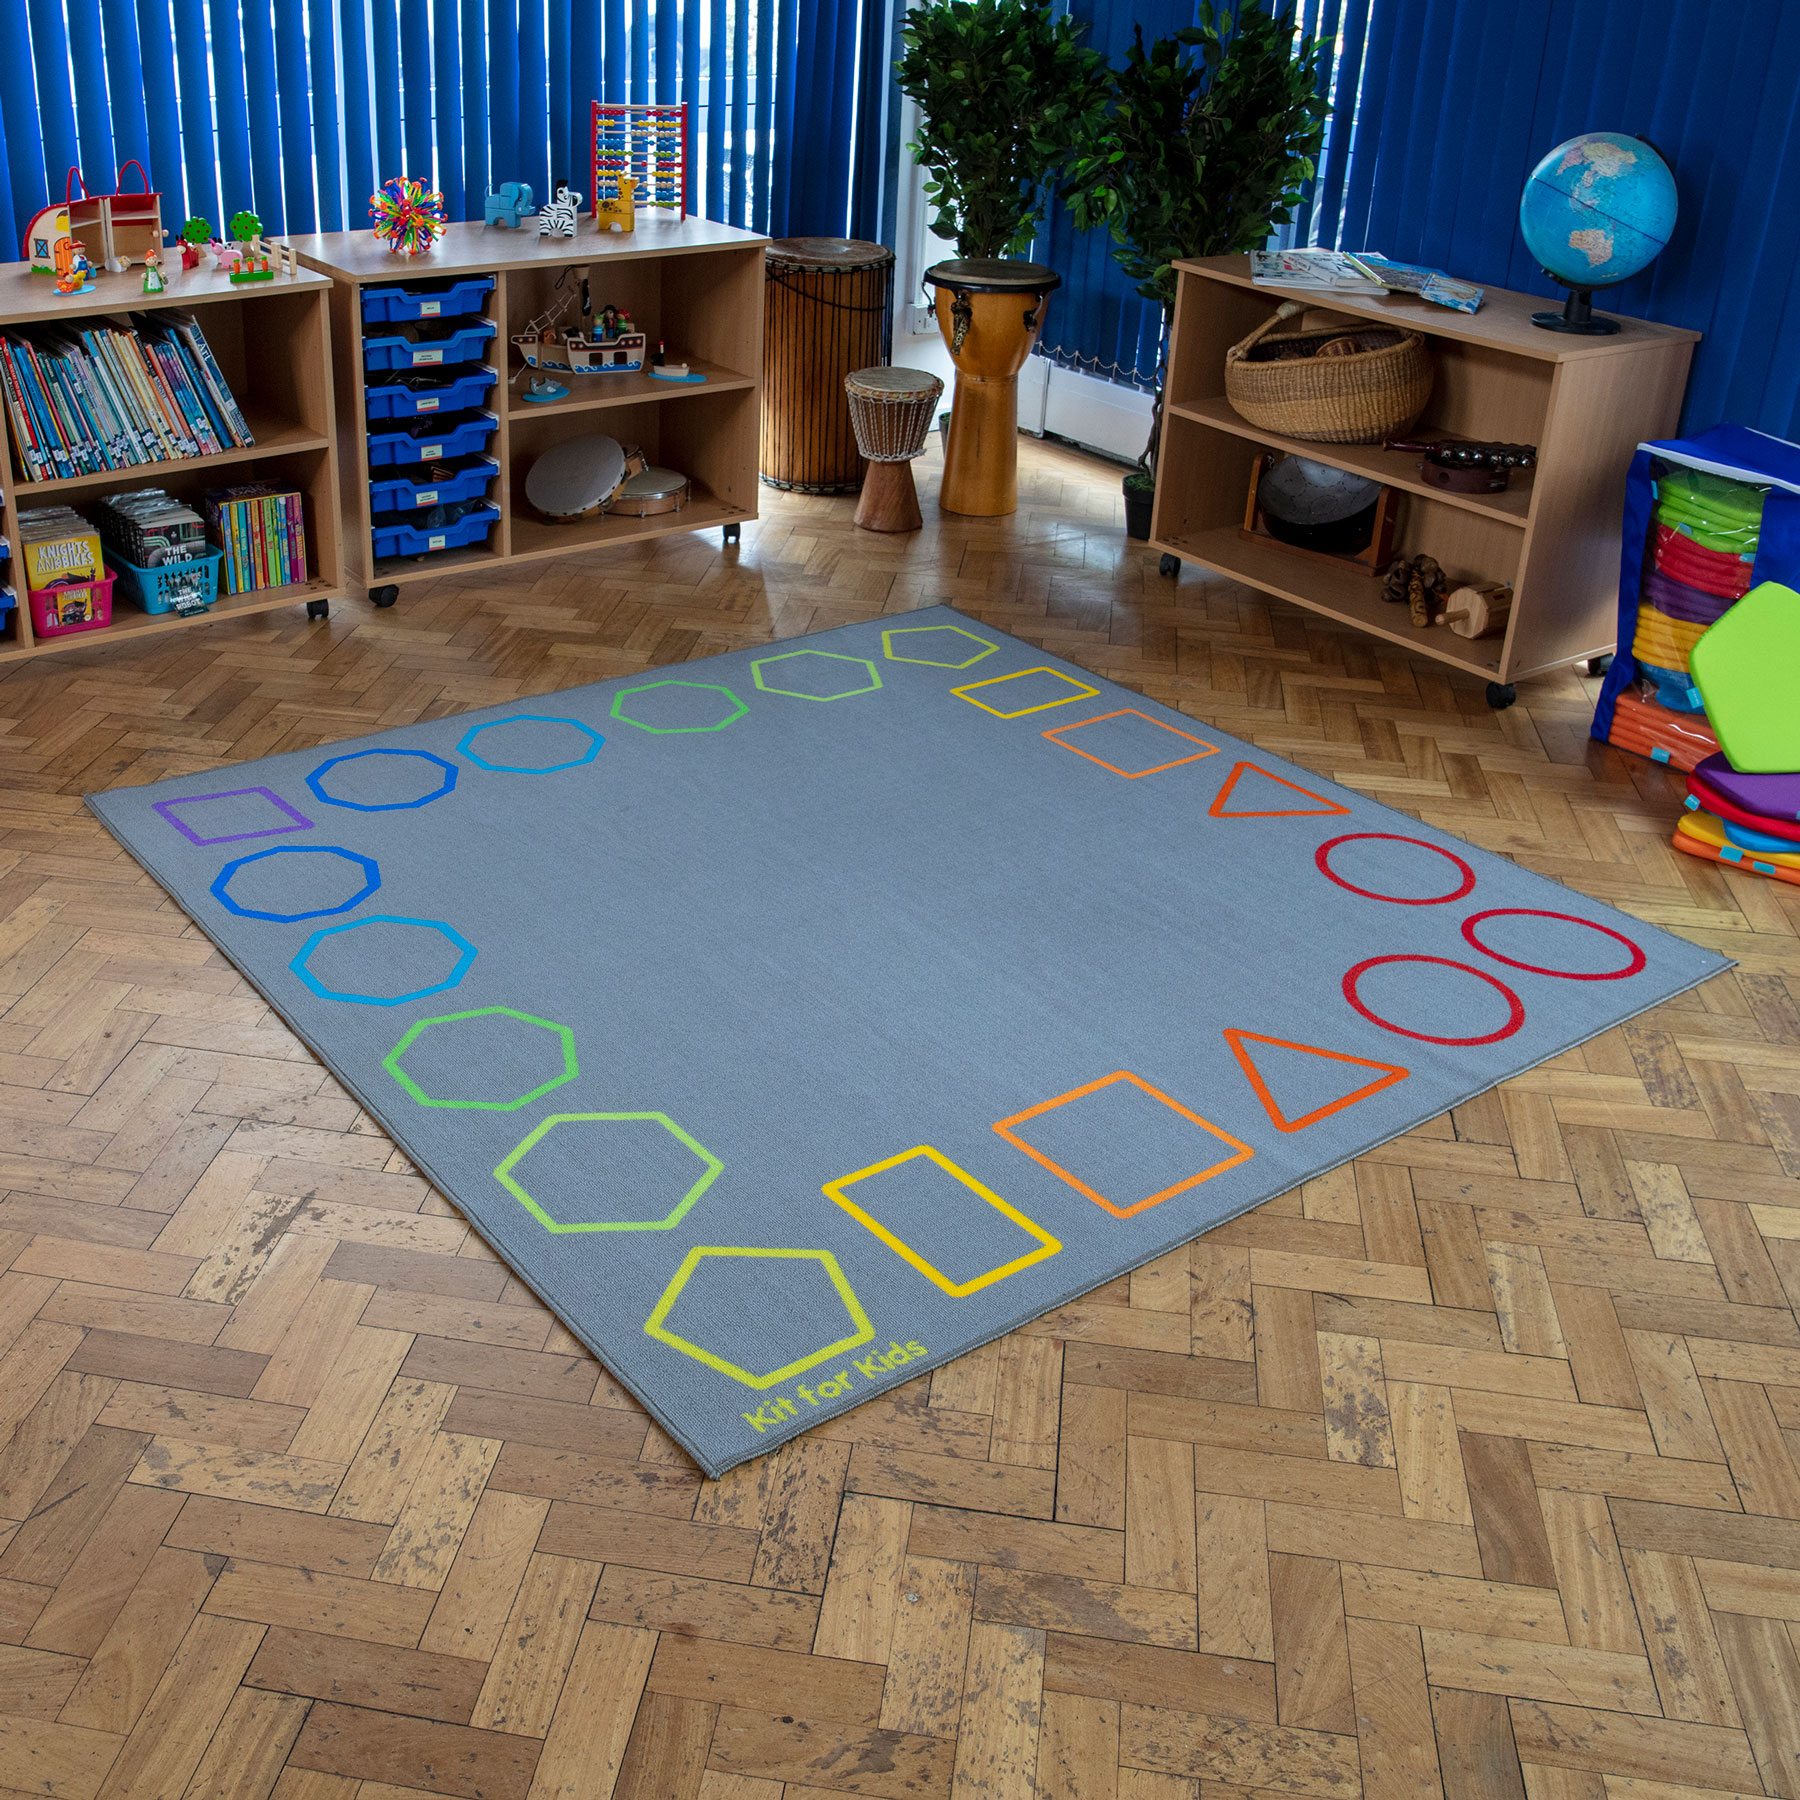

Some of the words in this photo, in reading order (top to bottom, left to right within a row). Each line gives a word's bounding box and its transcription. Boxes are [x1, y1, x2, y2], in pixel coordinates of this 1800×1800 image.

[198, 343, 211, 360] Art
[155, 376, 167, 399] MONET
[38, 540, 90, 559] KNIGHTS
[165, 545, 187, 556] THE
[37, 557, 62, 572] AND
[61, 552, 95, 569] BIKES
[162, 553, 193, 566] WILD
[178, 587, 192, 596] THE
[176, 598, 201, 610] ROBOT
[741, 1397, 798, 1433] Kit
[797, 1370, 854, 1406] for
[852, 1340, 929, 1379] Kids
